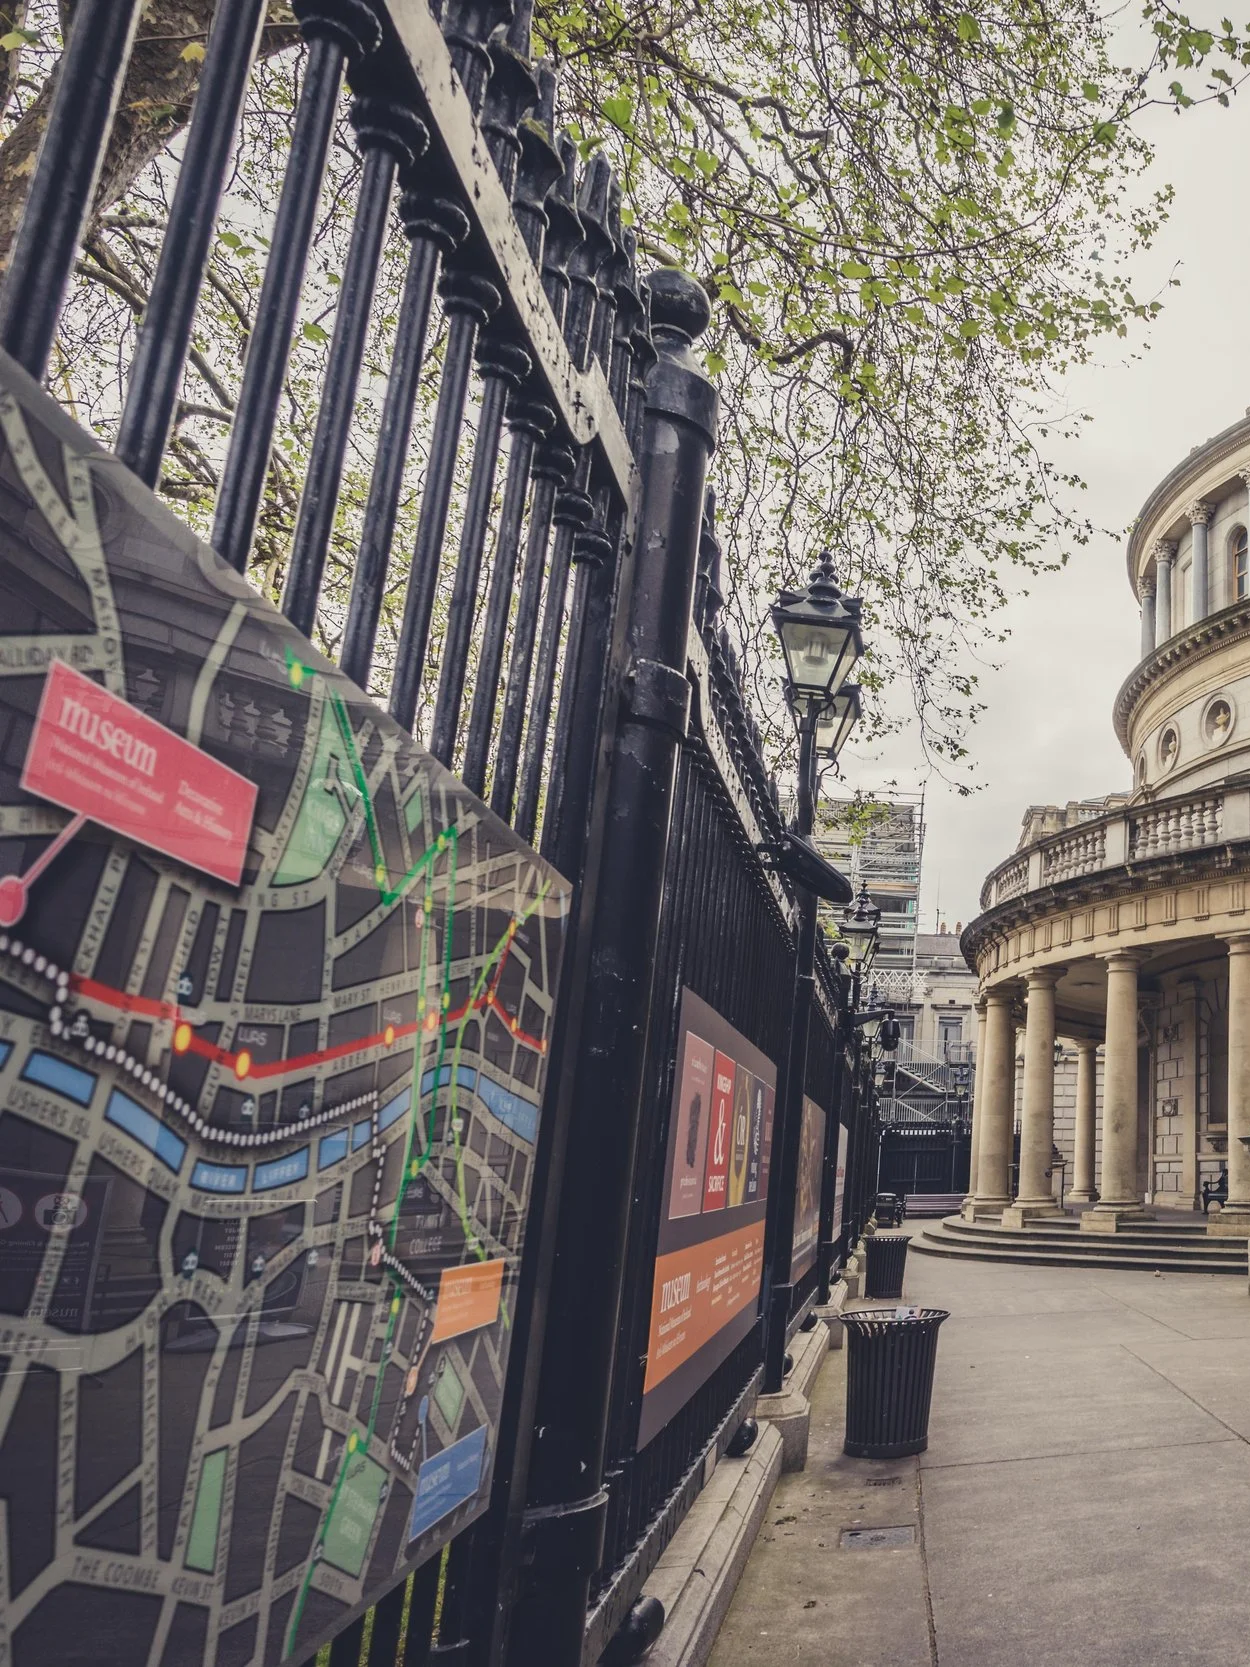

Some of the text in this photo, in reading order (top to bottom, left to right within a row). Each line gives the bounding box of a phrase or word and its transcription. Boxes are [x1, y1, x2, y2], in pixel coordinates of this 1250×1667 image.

[59, 696, 158, 777] museum
[713, 1098, 726, 1166] &
[199, 1169, 238, 1188] RIVER
[260, 1161, 300, 1184] LIFFEY
[659, 1271, 692, 1313] museum
